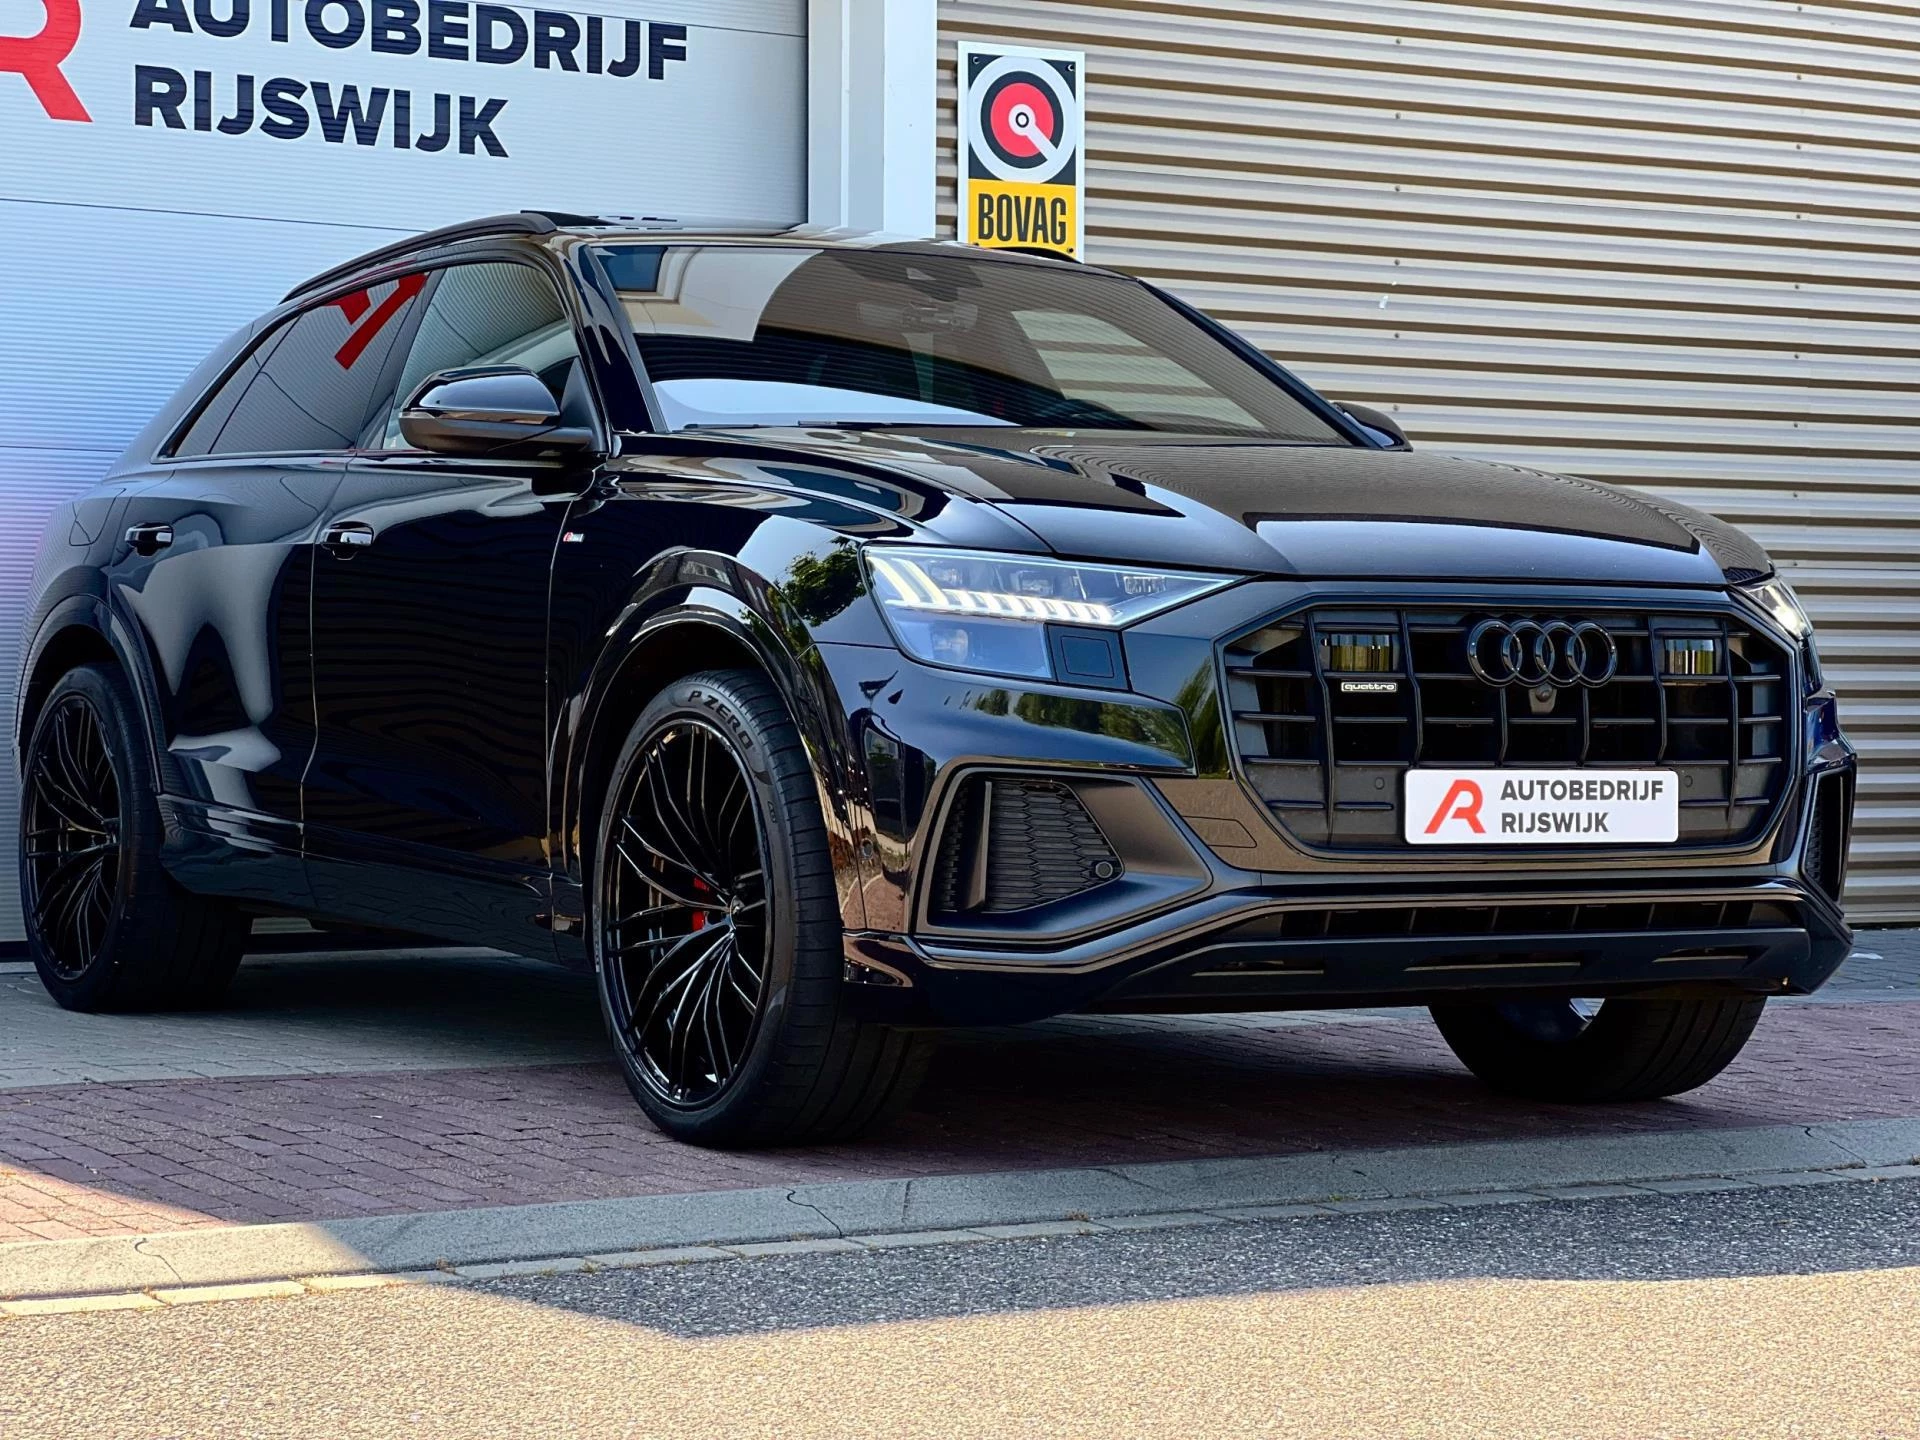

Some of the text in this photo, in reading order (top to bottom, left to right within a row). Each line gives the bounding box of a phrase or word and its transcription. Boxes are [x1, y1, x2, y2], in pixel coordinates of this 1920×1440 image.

[135, 64, 509, 158] RIJSWIJK
[978, 193, 1066, 245] BOVAG
[1343, 682, 1396, 692] quattro
[704, 695, 753, 749] ZERO
[1500, 780, 1663, 800] AUTOBEDRIJF
[1501, 812, 1609, 833] RIJSWIJK
